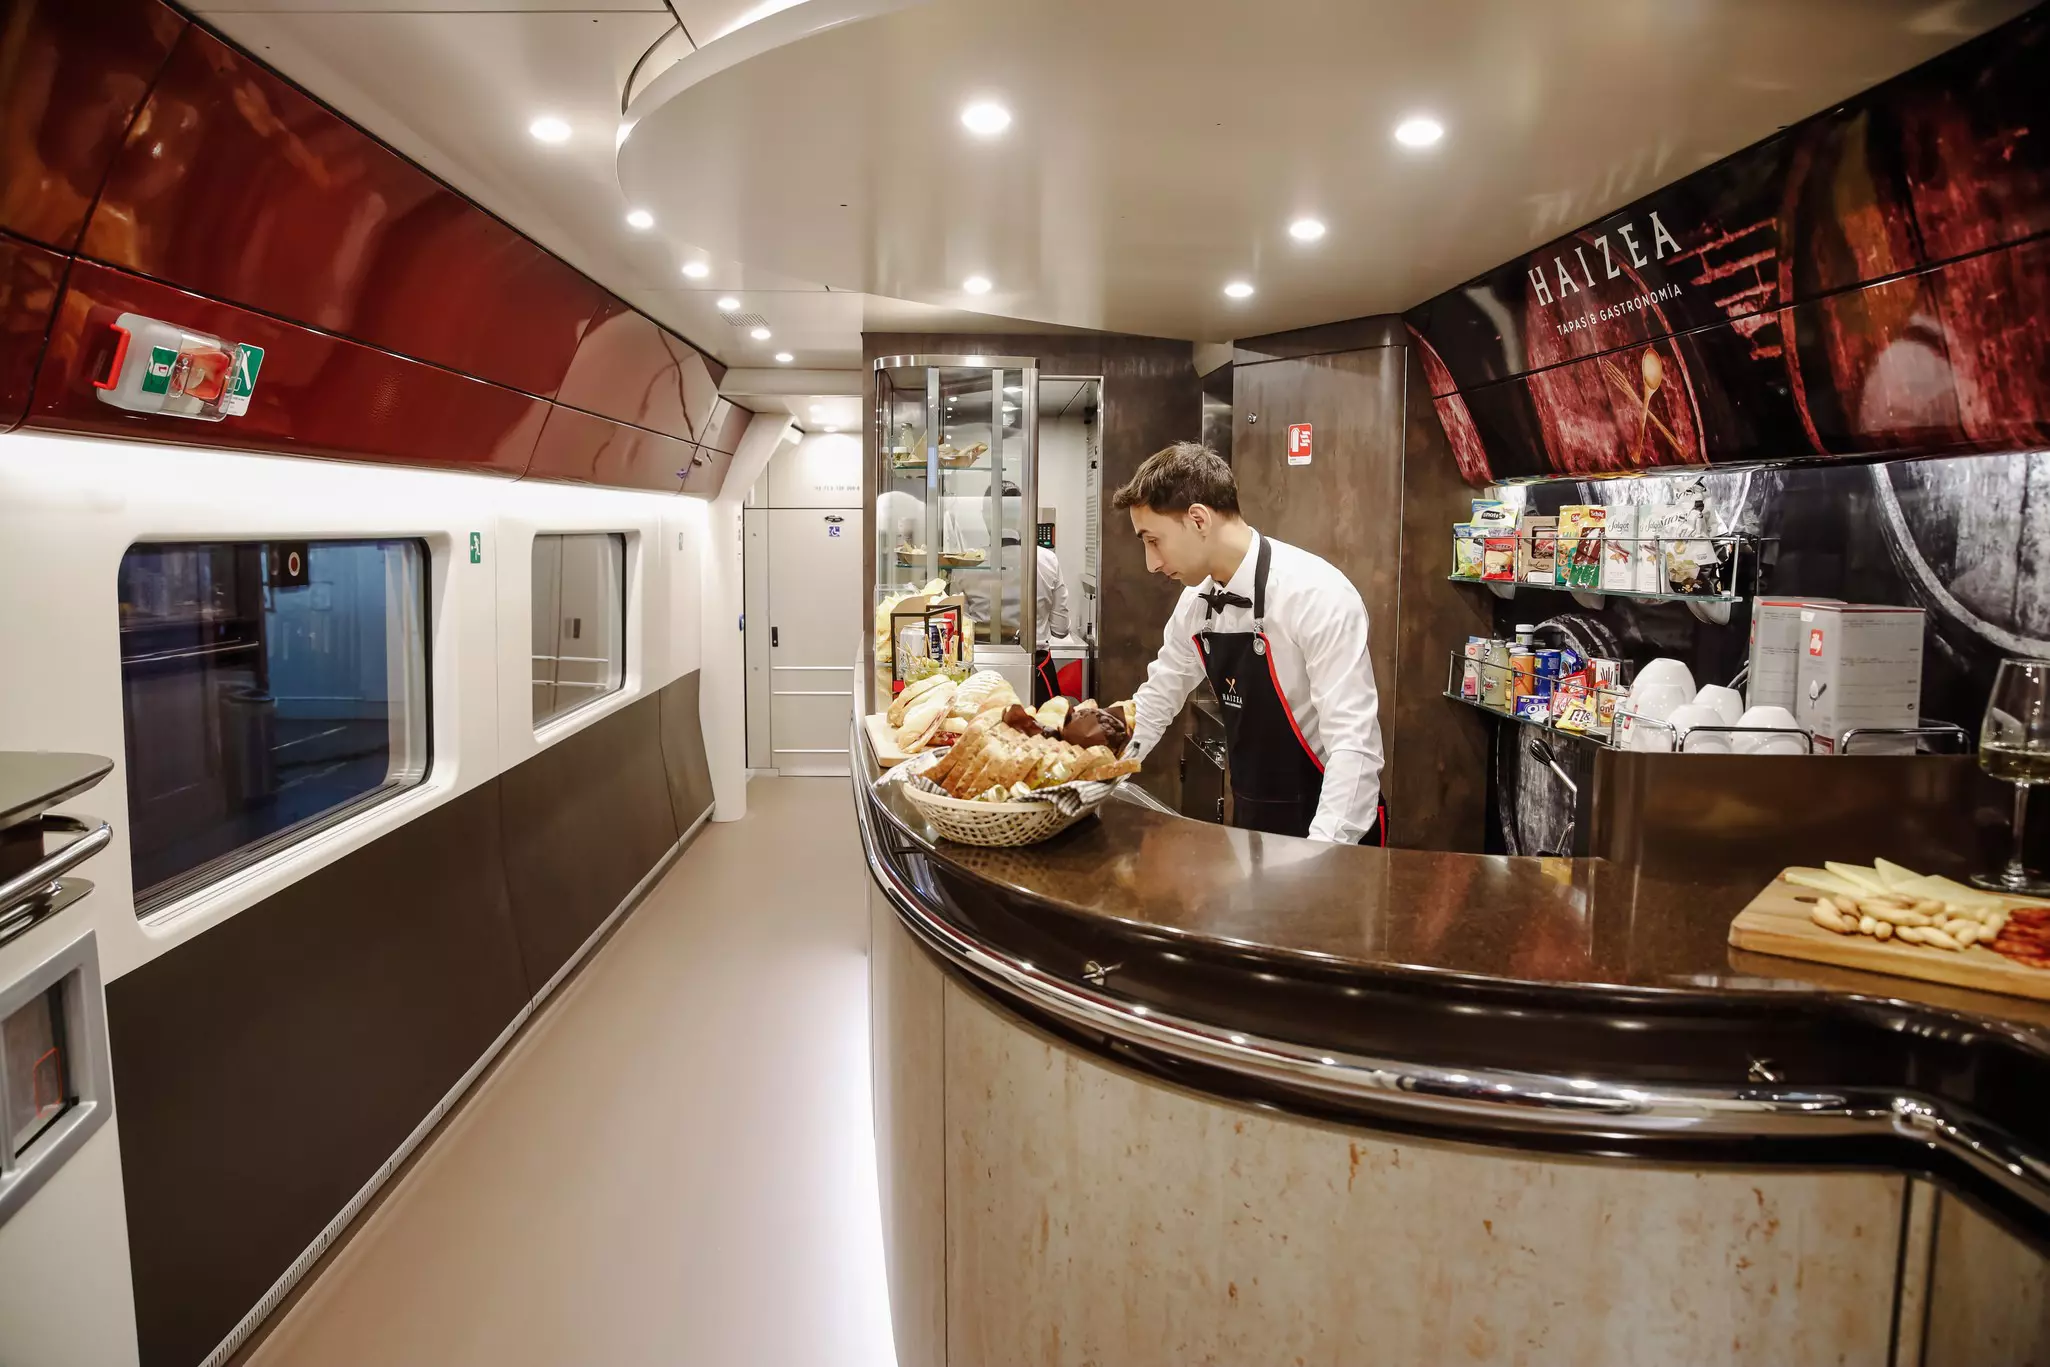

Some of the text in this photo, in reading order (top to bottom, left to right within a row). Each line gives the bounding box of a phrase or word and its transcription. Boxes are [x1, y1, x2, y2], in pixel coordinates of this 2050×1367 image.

[1528, 211, 1682, 307] HAIZEA
[1556, 282, 1683, 336] TAPAS & GASTRONOMÍA
